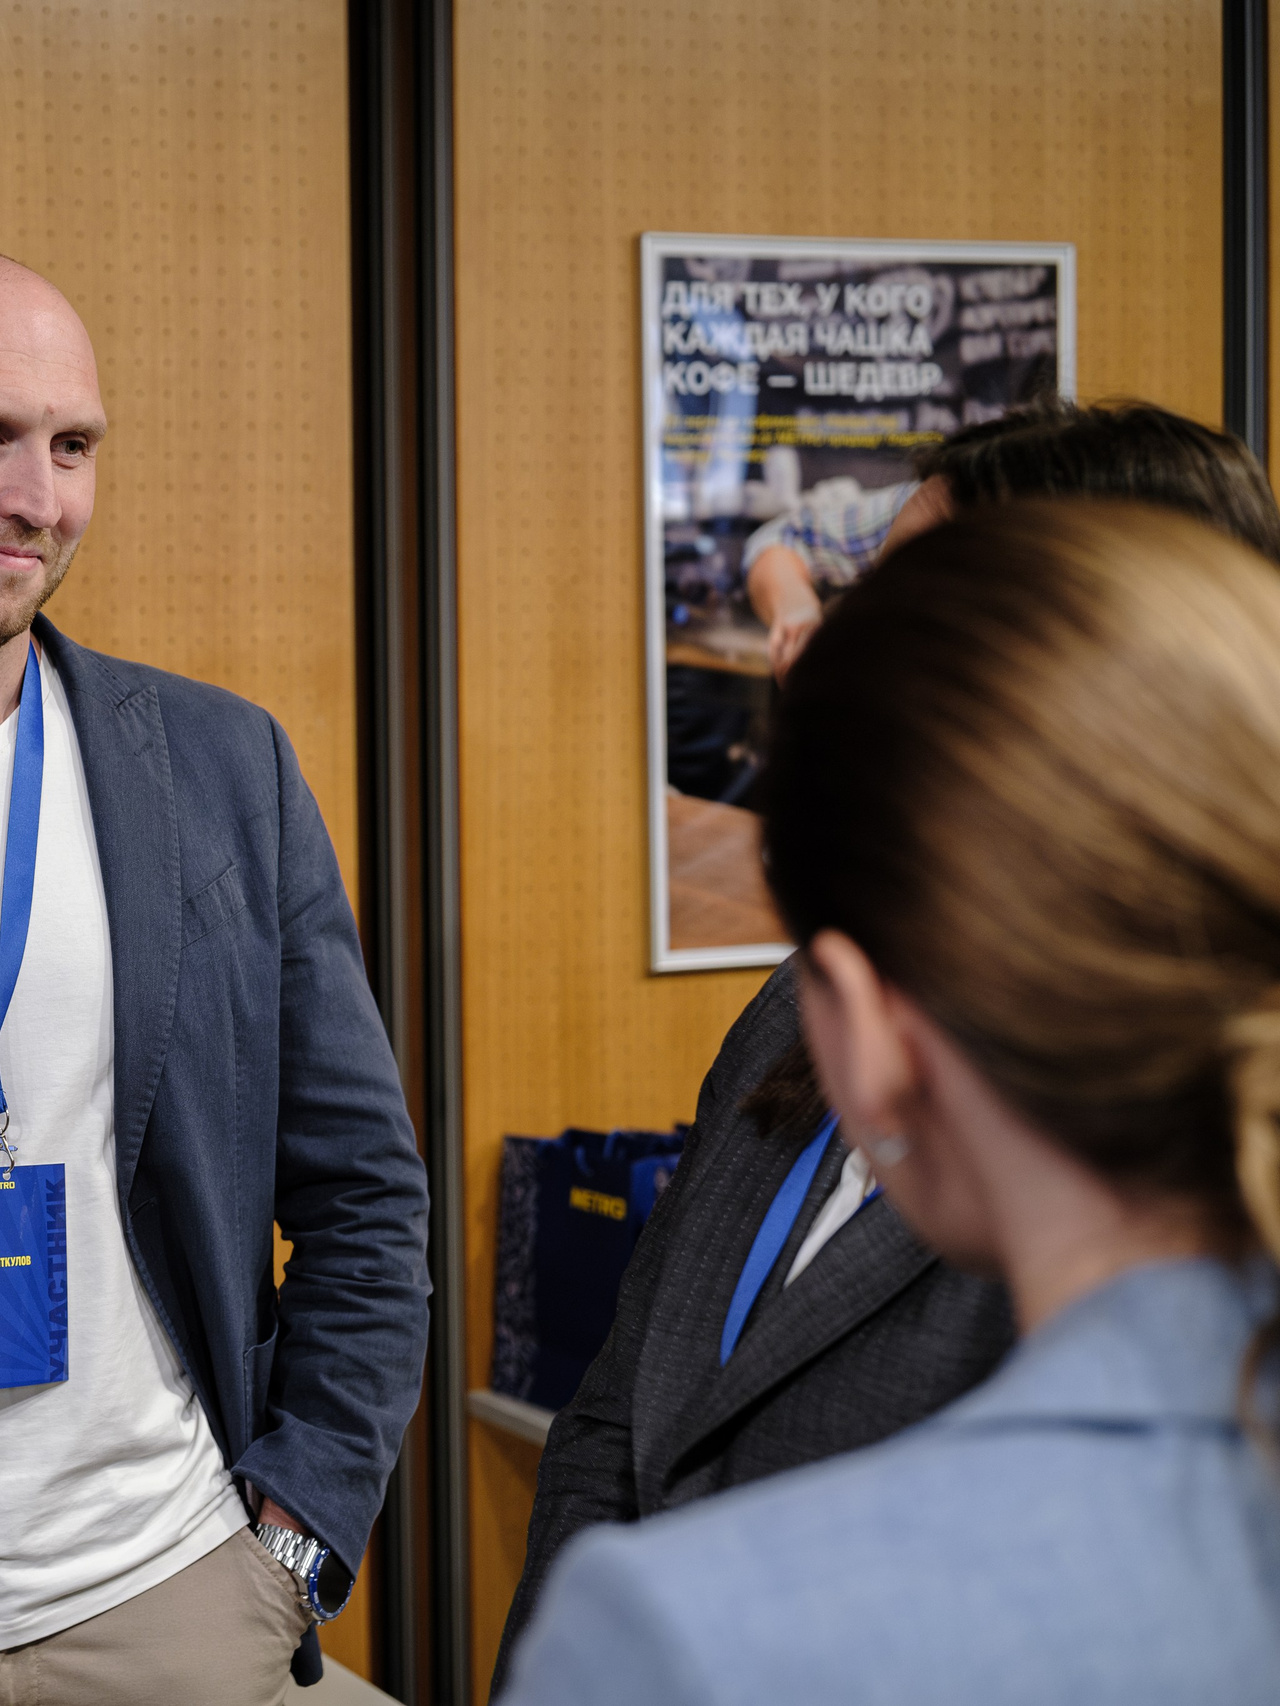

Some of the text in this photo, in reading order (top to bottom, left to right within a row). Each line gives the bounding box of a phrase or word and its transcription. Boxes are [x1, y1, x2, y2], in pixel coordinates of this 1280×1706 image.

[662, 280, 934, 320] ДЛЯ ТЕХ, У КОГО
[663, 321, 934, 361] КАЖДАЯ ЧАШКА
[663, 361, 760, 396] КОФЕ
[803, 361, 943, 403] ШЕДЕВР
[46, 1178, 68, 1382] УЧАСТНИК
